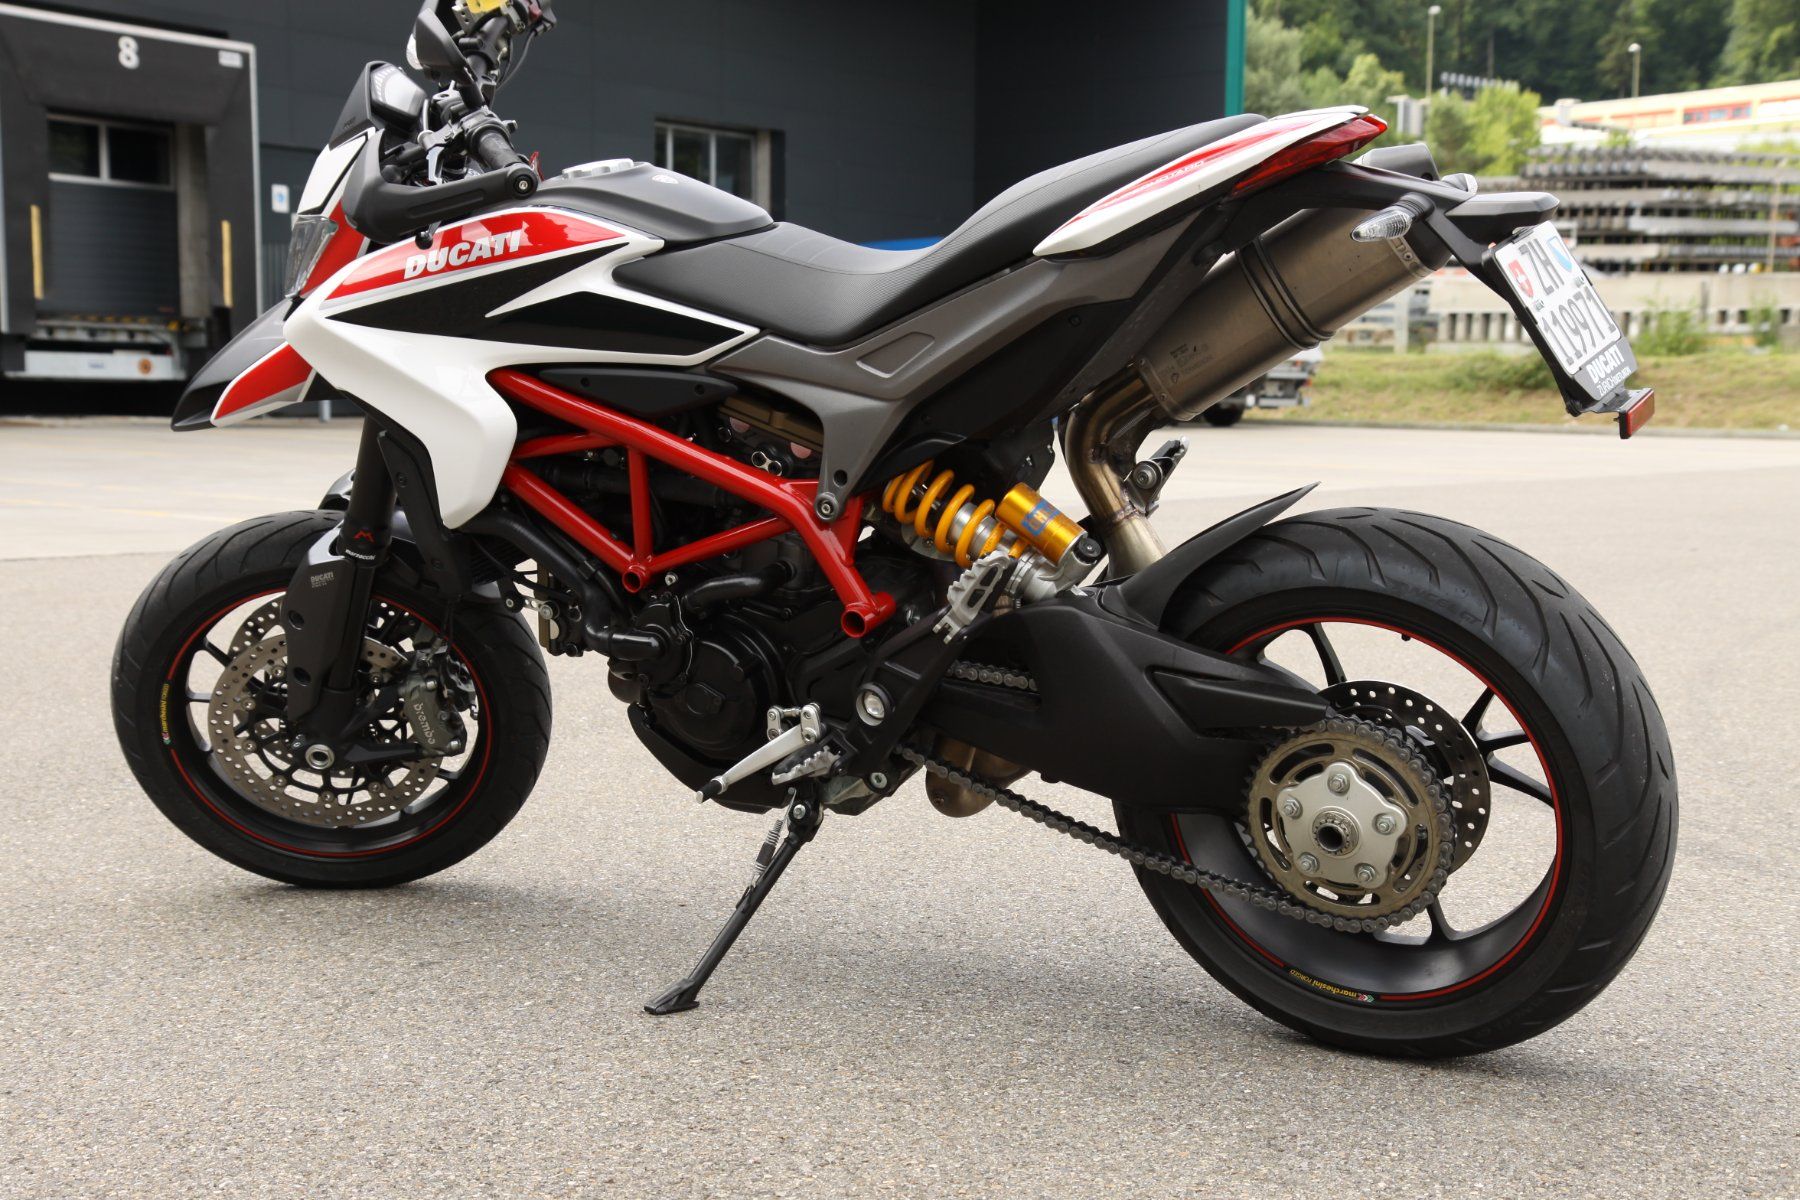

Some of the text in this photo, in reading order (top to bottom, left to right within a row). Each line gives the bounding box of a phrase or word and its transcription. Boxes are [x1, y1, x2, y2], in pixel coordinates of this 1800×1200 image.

[118, 36, 140, 70] 8
[404, 230, 522, 280] DUCATI
[1519, 238, 1564, 296] ZH
[1542, 286, 1617, 366] 119971
[1586, 344, 1625, 384] DUCATI
[310, 571, 334, 582] DUCATI
[413, 702, 436, 745] brembo
[1311, 979, 1358, 998] marchesini
